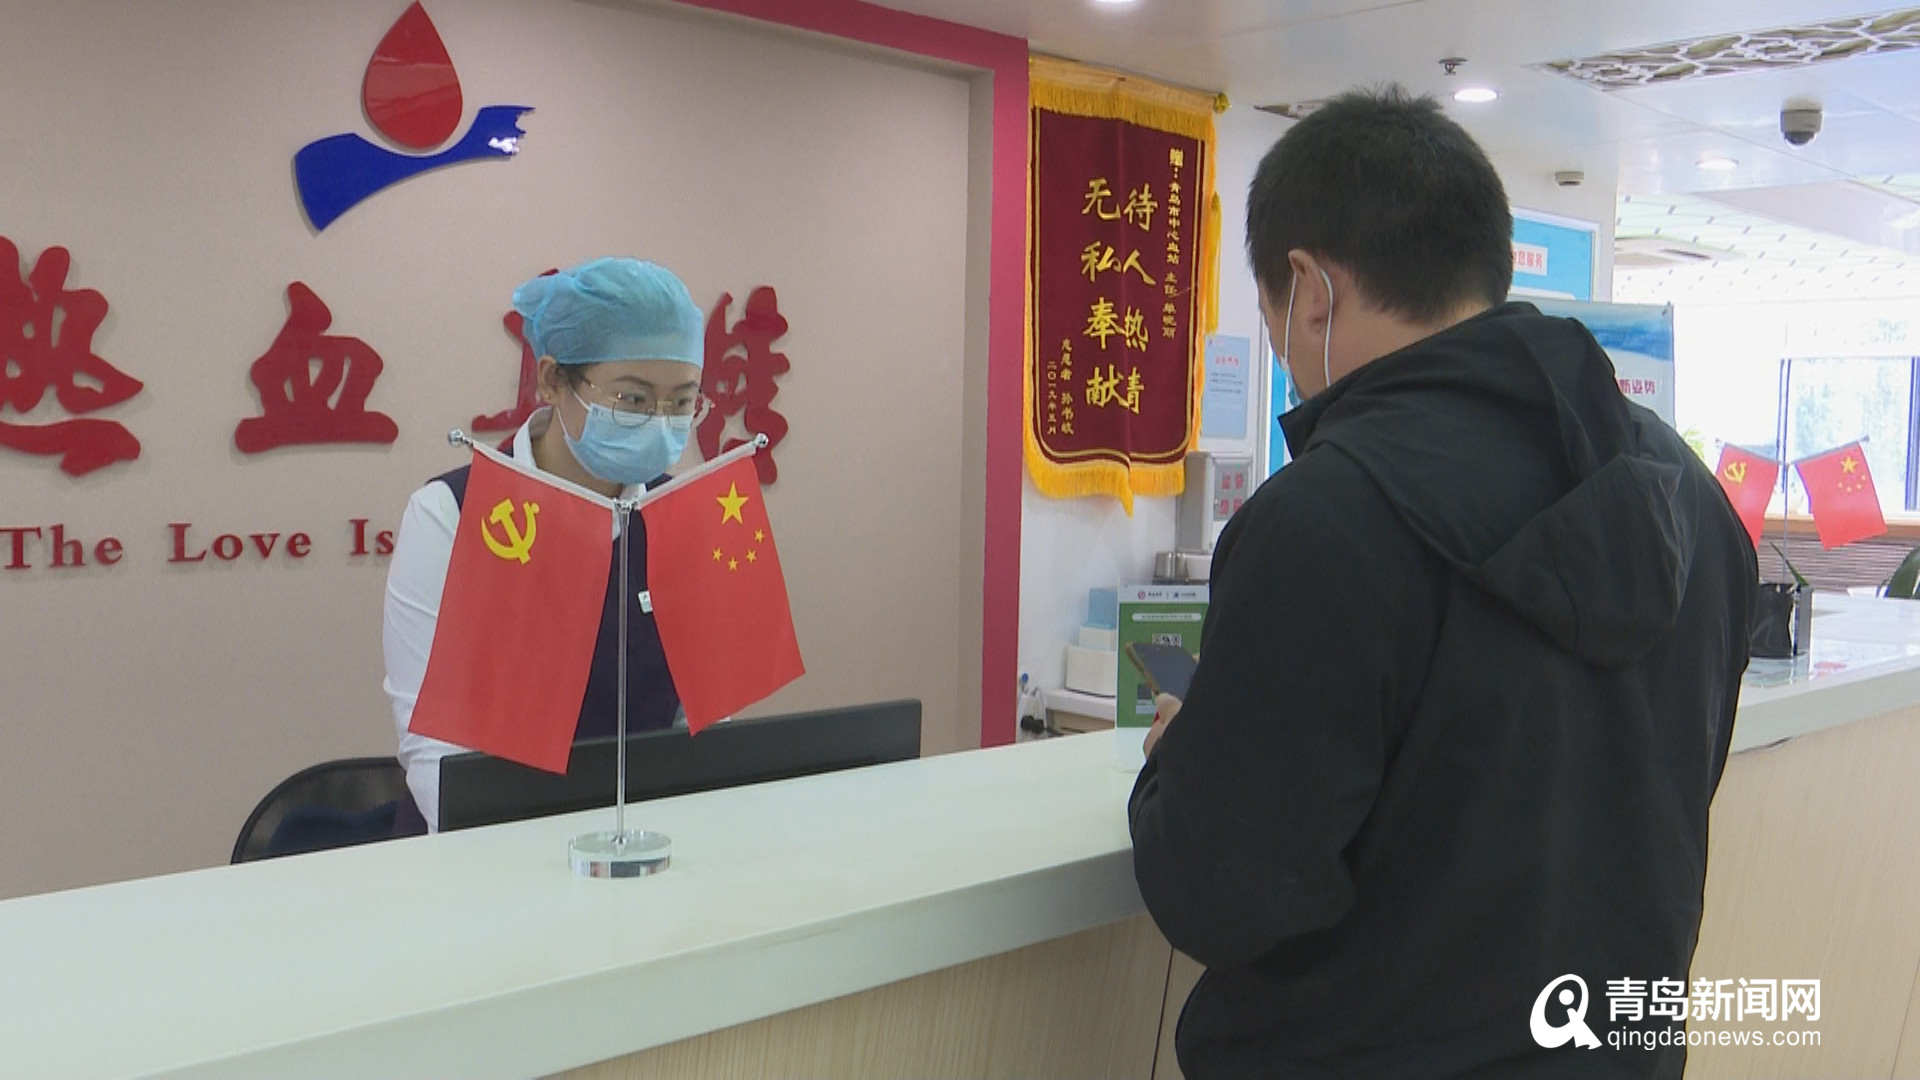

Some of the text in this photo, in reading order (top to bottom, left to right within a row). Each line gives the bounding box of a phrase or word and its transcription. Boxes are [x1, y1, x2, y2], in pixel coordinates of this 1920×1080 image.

[0, 235, 791, 485] 热血情
[1081, 177, 1130, 409] 无私奉献
[0, 518, 394, 570] The Love Is
